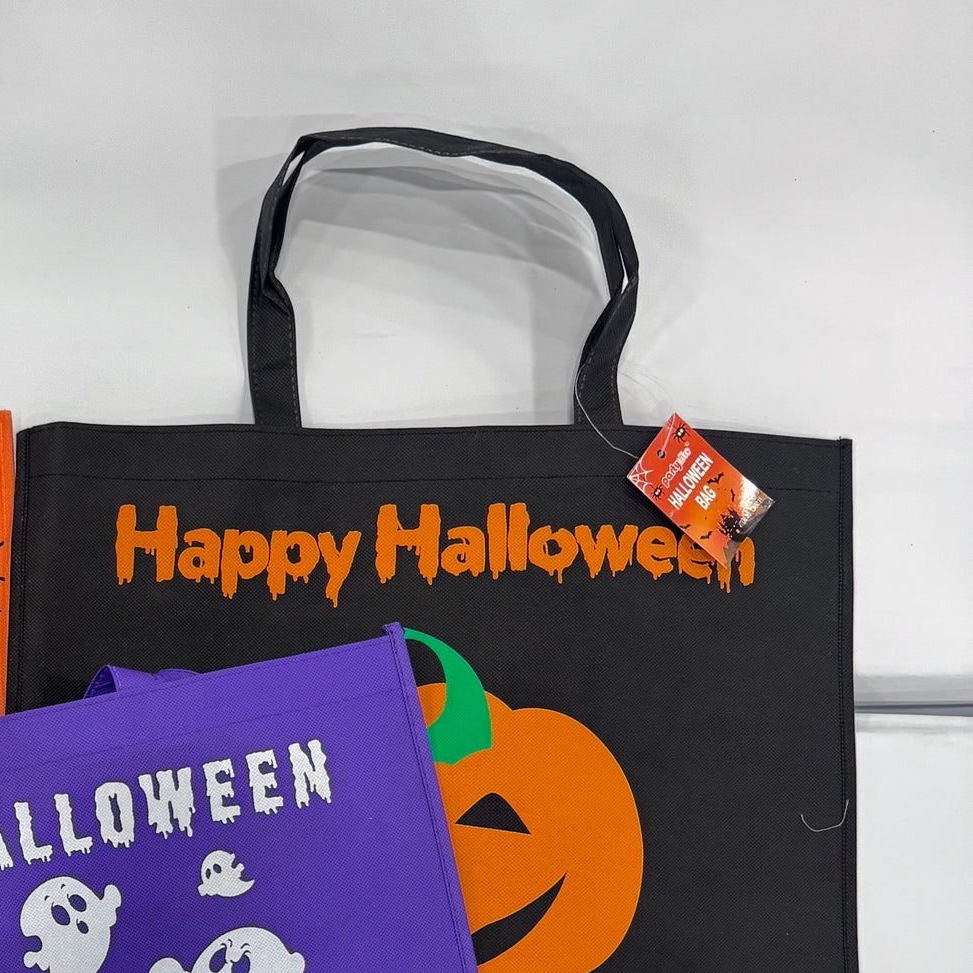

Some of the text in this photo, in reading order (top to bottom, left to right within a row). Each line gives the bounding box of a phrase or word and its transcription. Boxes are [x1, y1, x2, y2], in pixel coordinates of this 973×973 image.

[667, 451, 714, 511] HALLOWEEN
[694, 484, 717, 511] BAG
[115, 502, 755, 607] Happy Halloween
